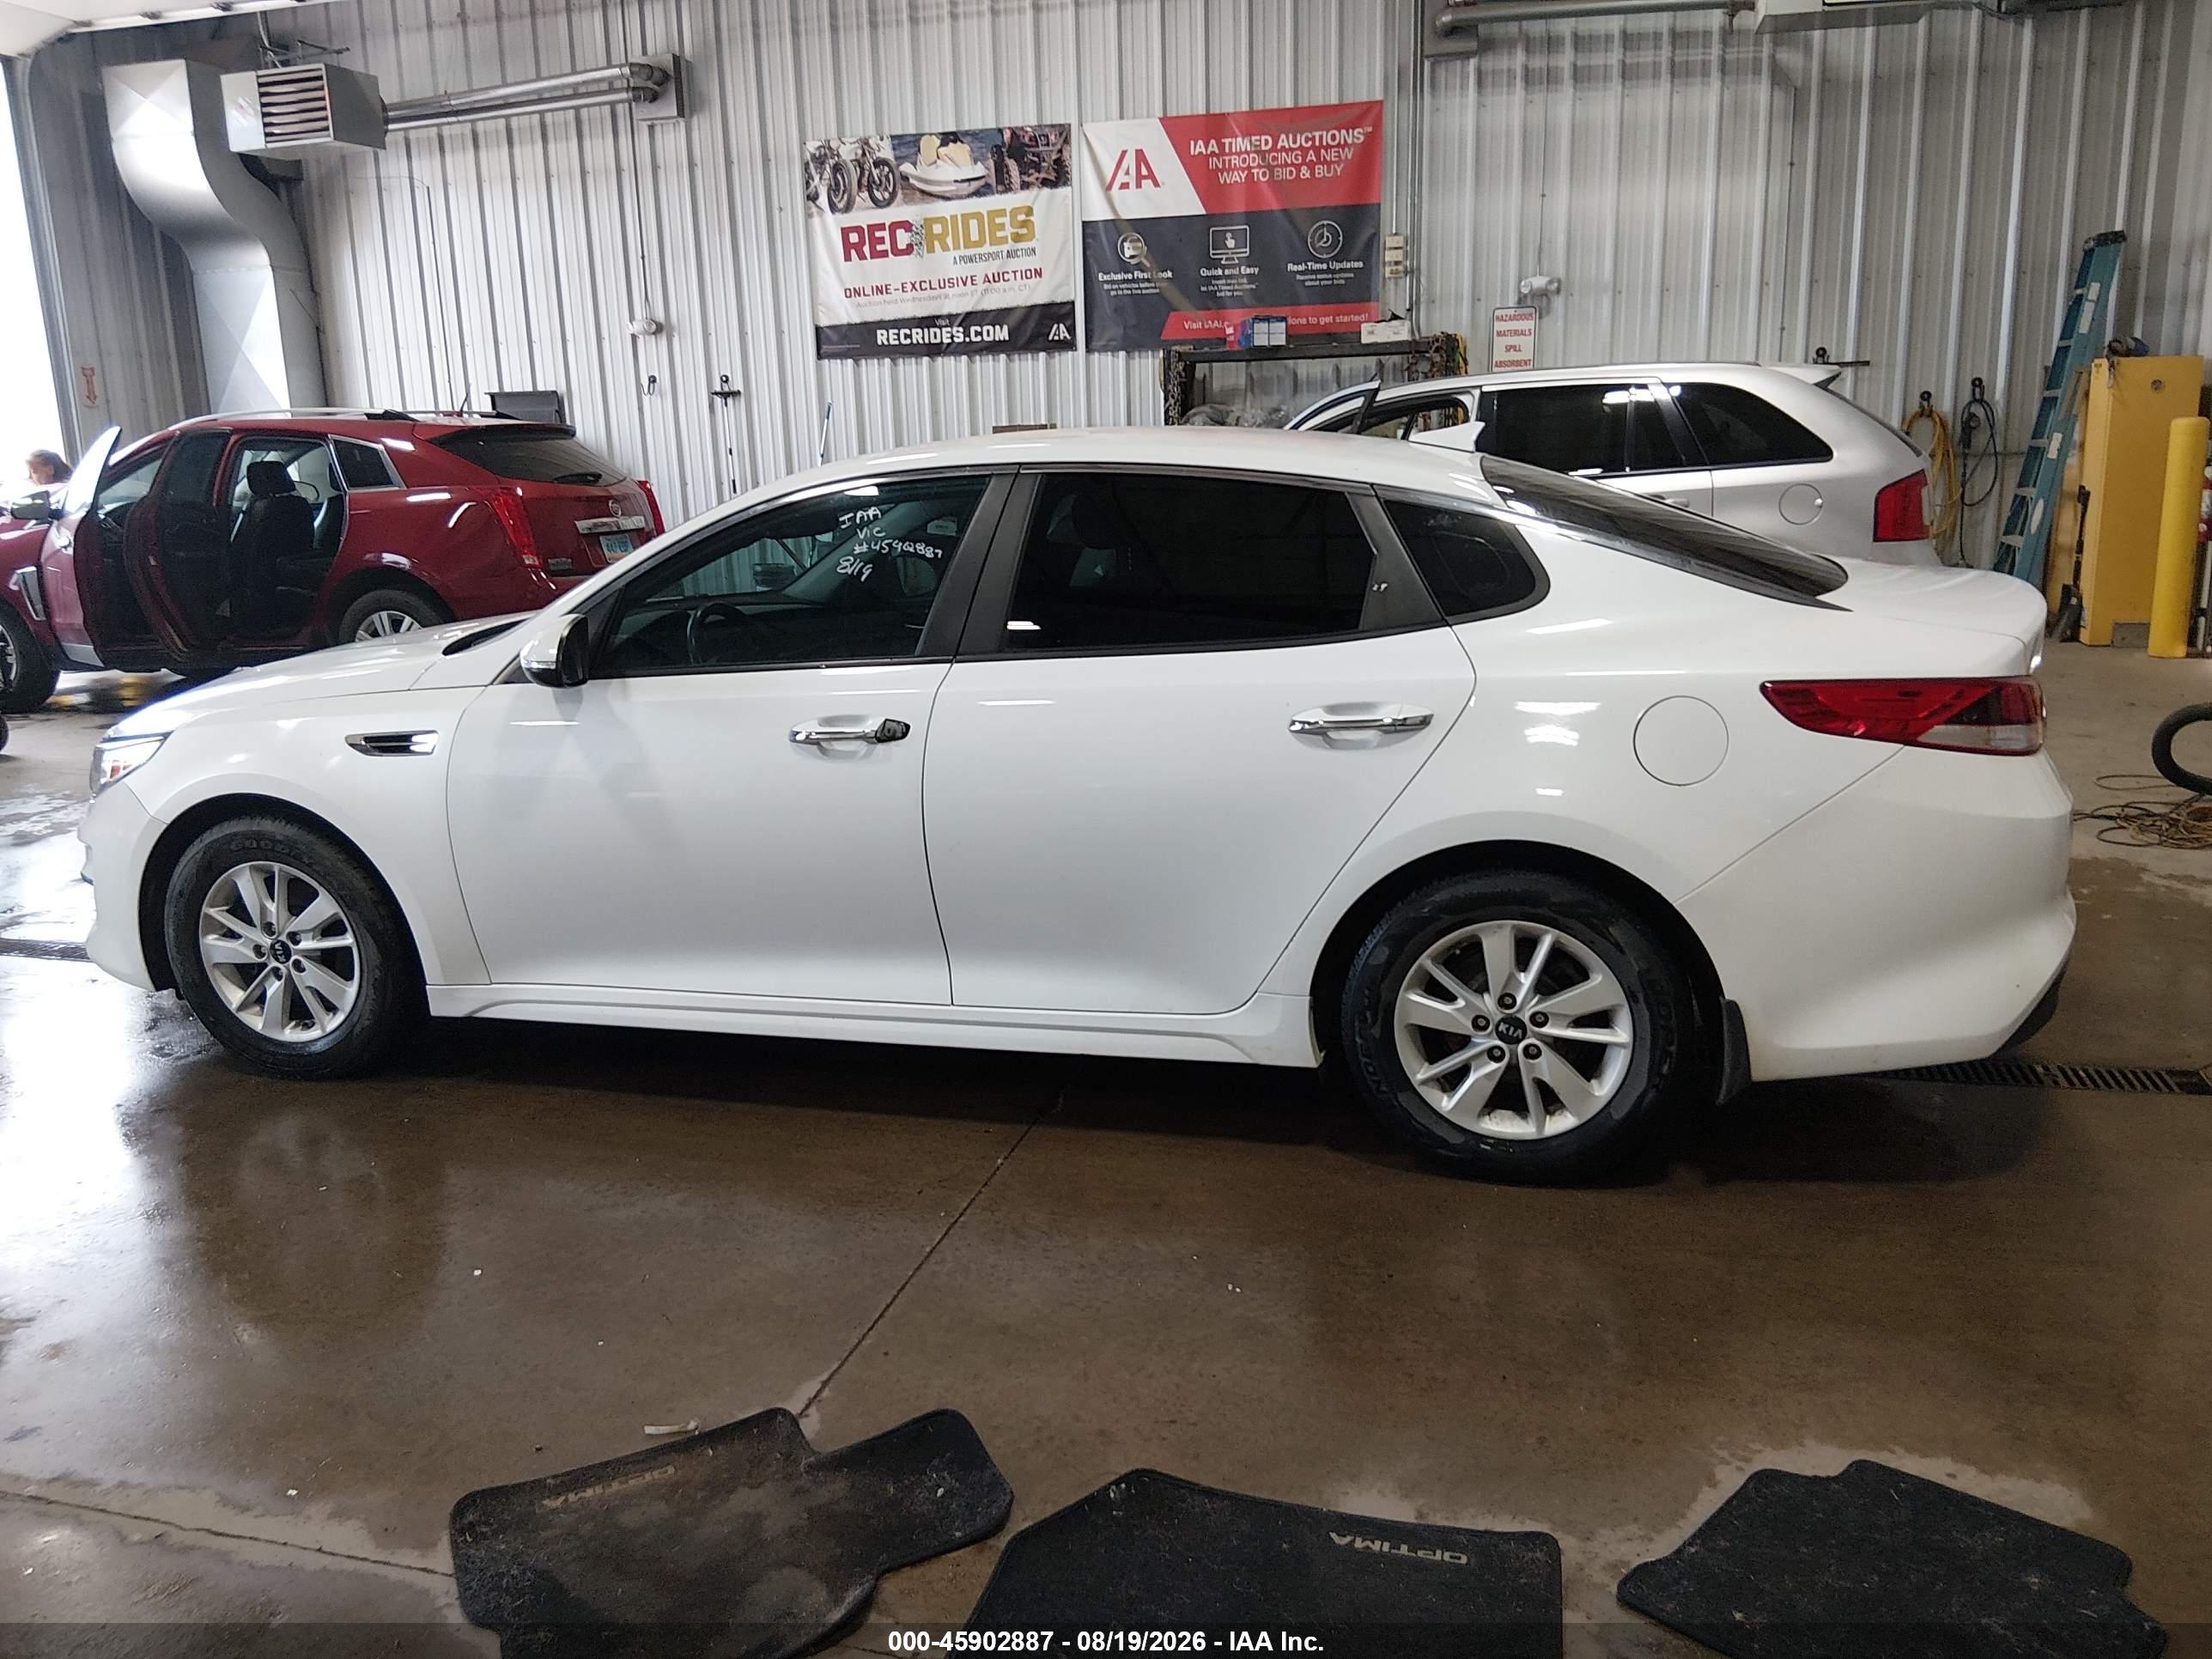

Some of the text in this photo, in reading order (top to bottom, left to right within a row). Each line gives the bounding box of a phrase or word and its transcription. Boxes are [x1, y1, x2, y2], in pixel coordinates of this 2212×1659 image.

[1189, 139, 1218, 155] IAA
[1222, 135, 1273, 153] TIMED
[1209, 147, 1354, 170] INTRODUCING A NEW
[1218, 163, 1344, 185] WAY TO BID & BUY
[841, 205, 1036, 262] REC RIDES
[958, 251, 1005, 264] POWERSPORT
[1006, 246, 1037, 259] AUCTION
[1200, 265, 1259, 276] Quick and Easy
[1288, 260, 1364, 272] Real-Time Updates
[844, 267, 1042, 299] ONLINE-EXCLUSIVE AUCTION
[1099, 270, 1173, 281] Exclusive First Look
[1183, 320, 1202, 330] Visit
[1320, 316, 1334, 326] get
[1335, 313, 1368, 323] started!
[1496, 313, 1534, 322] HAZARDOUS
[876, 325, 1009, 346] RECRIDES.COM
[1494, 359, 1532, 368] ABSORBENT
[1328, 1531, 1469, 1565] OPTIMA
